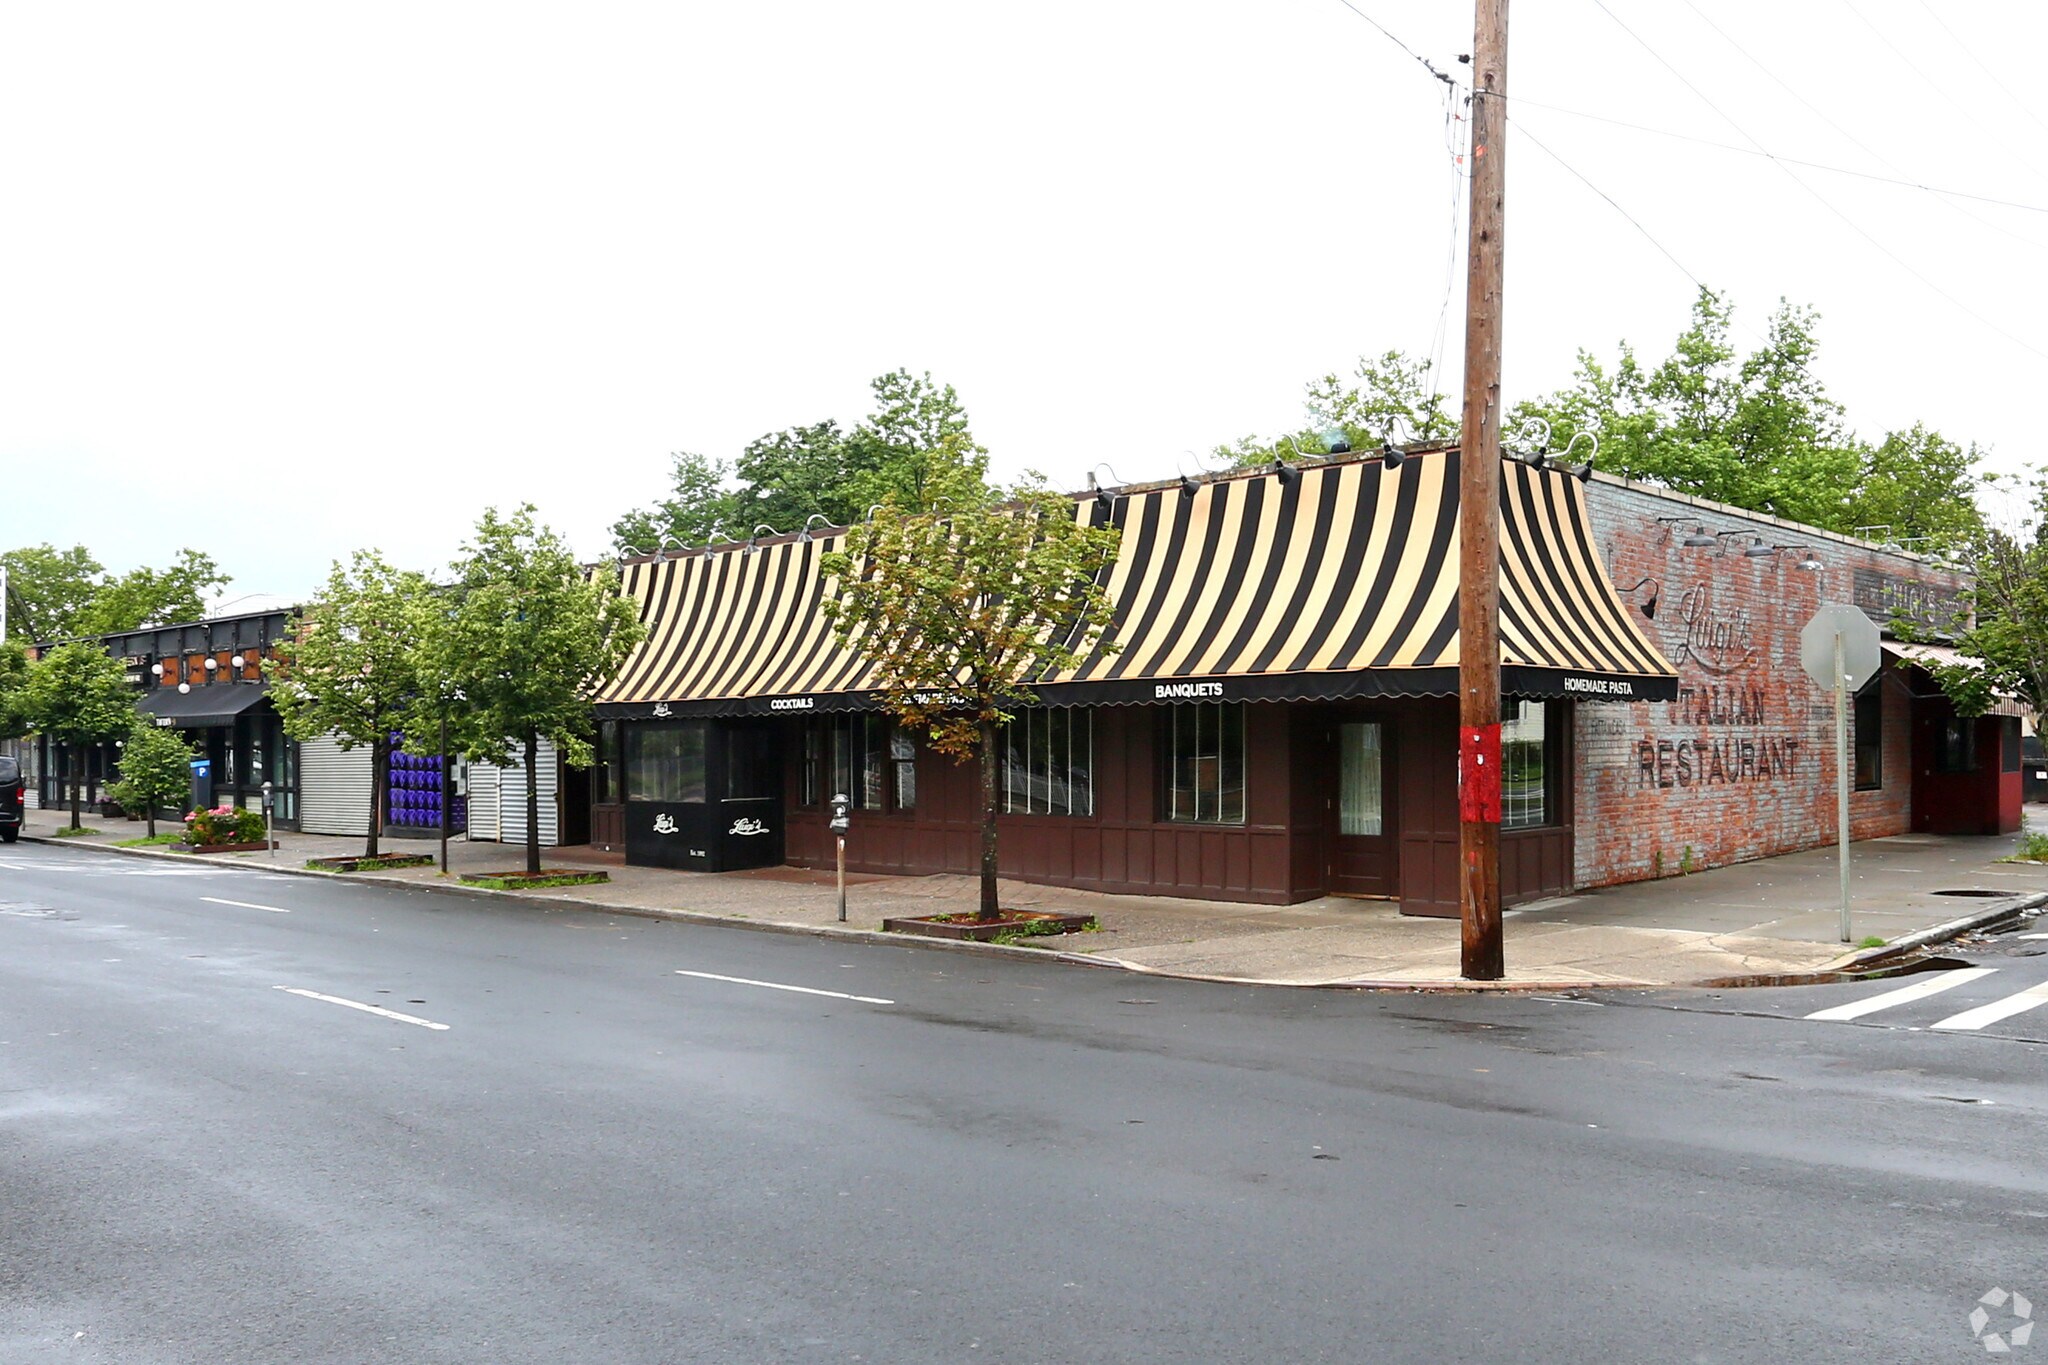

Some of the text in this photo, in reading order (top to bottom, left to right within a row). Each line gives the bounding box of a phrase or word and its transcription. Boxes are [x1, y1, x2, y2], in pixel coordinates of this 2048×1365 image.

[1674, 581, 1759, 675] Luigi's
[1155, 682, 1223, 698] BANQUETS
[1564, 677, 1633, 695] HOMEMADE PASTA
[771, 697, 814, 710] COCKTAILS
[1668, 684, 1766, 726] ITALIAN
[199, 767, 206, 776] P
[1638, 735, 1799, 790] RESTAURANT
